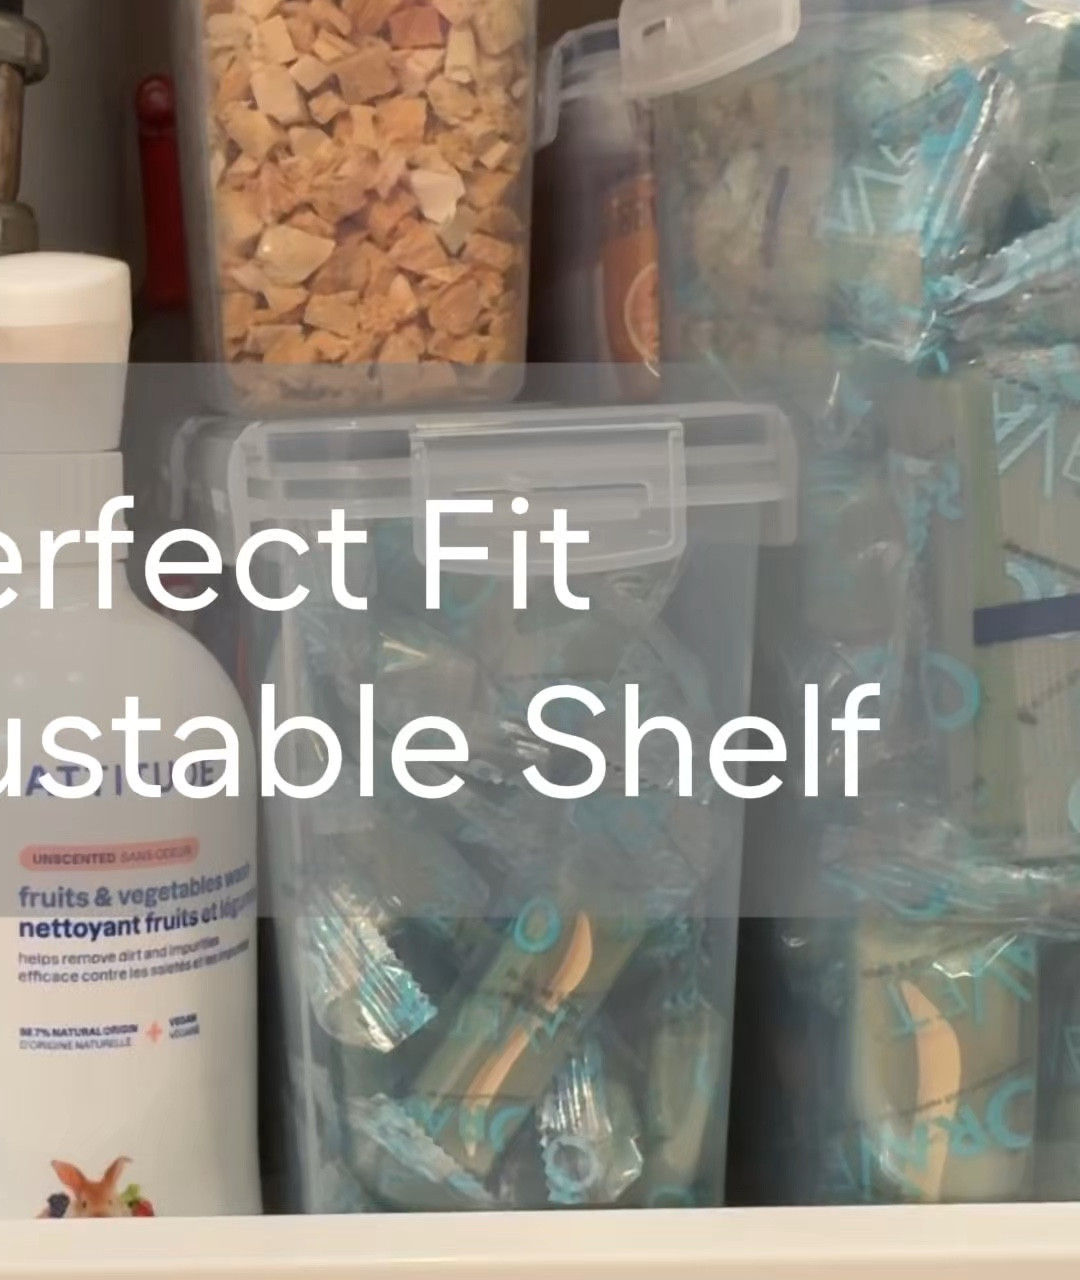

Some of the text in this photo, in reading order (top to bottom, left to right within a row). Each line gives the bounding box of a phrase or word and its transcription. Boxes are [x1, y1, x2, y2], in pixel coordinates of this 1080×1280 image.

[32, 851, 116, 866] UNSCENTED
[18, 886, 90, 908] fruits
[94, 886, 112, 907] &
[117, 875, 222, 907] vegetables
[19, 917, 141, 942] nettoyant
[146, 907, 199, 934] fruits
[201, 902, 218, 923] et
[18, 951, 60, 966] helps
[62, 952, 116, 966] remove
[118, 947, 142, 963] dirt
[144, 945, 167, 961] and
[18, 969, 79, 984] efficace
[81, 967, 127, 983] contre
